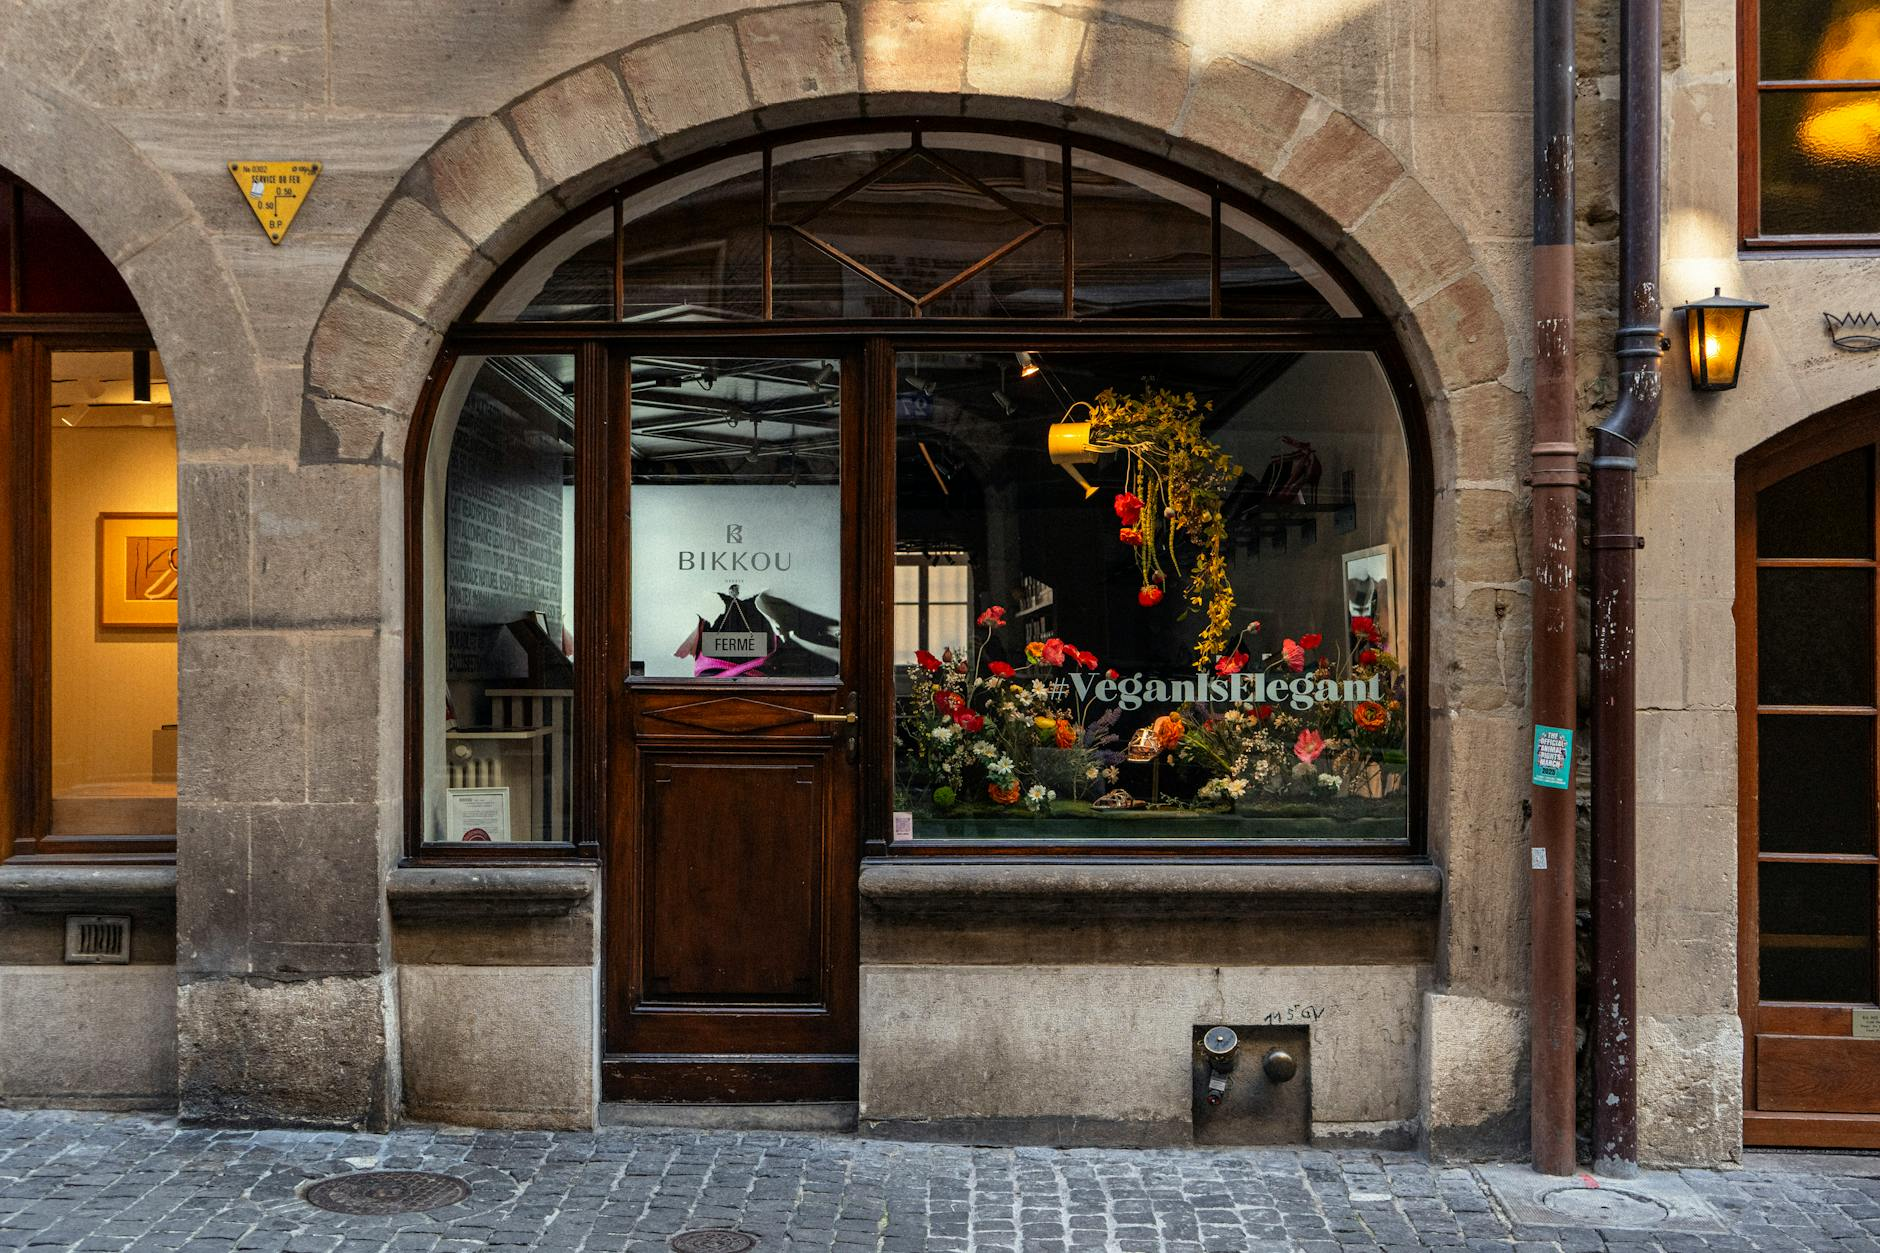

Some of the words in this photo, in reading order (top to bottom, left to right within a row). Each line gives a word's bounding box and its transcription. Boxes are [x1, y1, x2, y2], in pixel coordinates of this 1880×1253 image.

[252, 175, 276, 184] SERVICE
[279, 175, 286, 184] DU
[289, 175, 300, 184] FEU
[679, 551, 791, 571] BIKKOU
[715, 636, 755, 651] FERMÉ
[1049, 672, 1385, 711] #VeganIsElegant
[1548, 732, 1558, 740] THE
[1540, 738, 1564, 747] OFFICIAL
[1540, 745, 1562, 753] ANIMAL
[1540, 759, 1561, 768] MARCH
